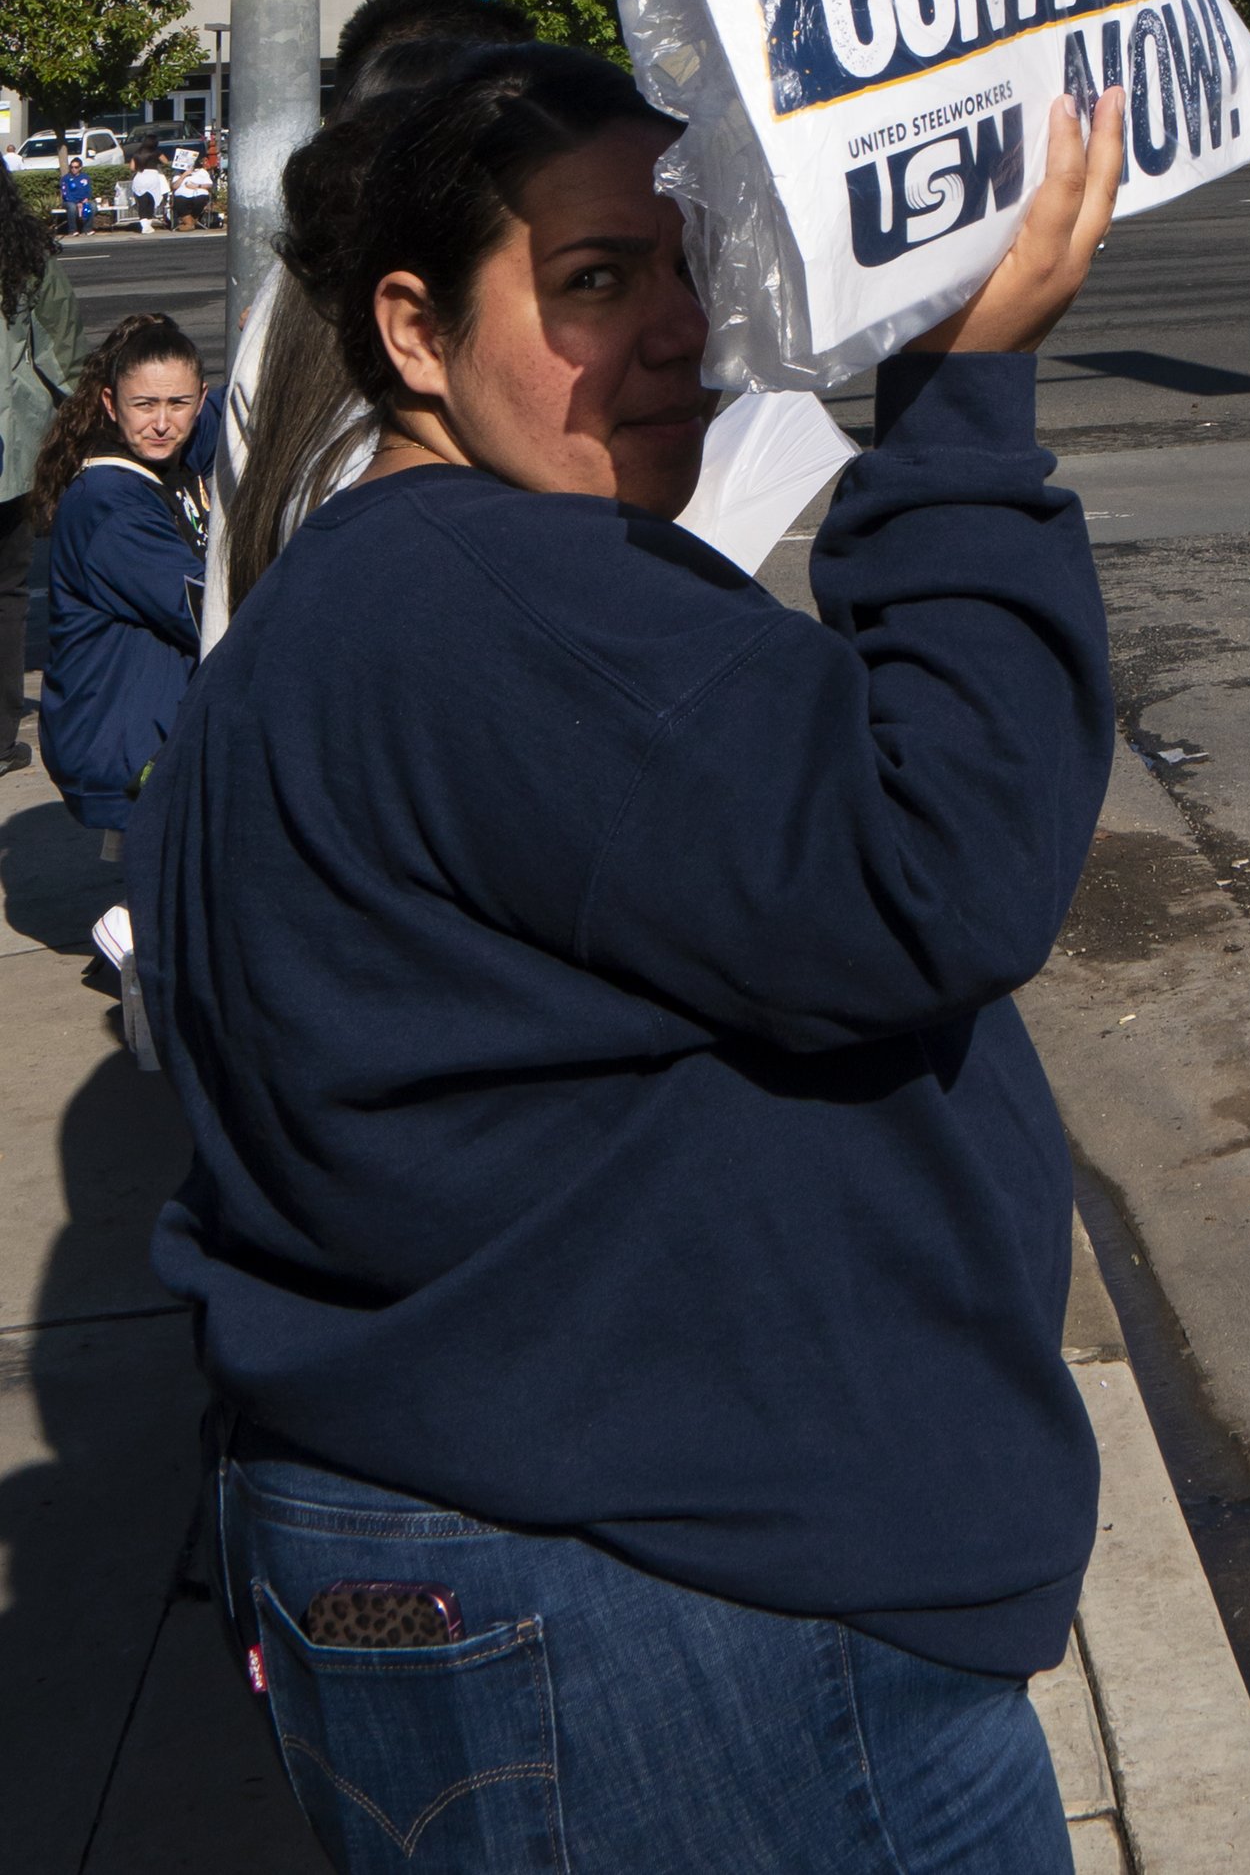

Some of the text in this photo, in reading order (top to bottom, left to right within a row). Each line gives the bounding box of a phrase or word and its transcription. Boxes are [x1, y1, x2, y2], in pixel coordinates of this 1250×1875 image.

[848, 79, 1014, 159] UNITED STEELWORKERS
[844, 102, 1025, 268] USW
